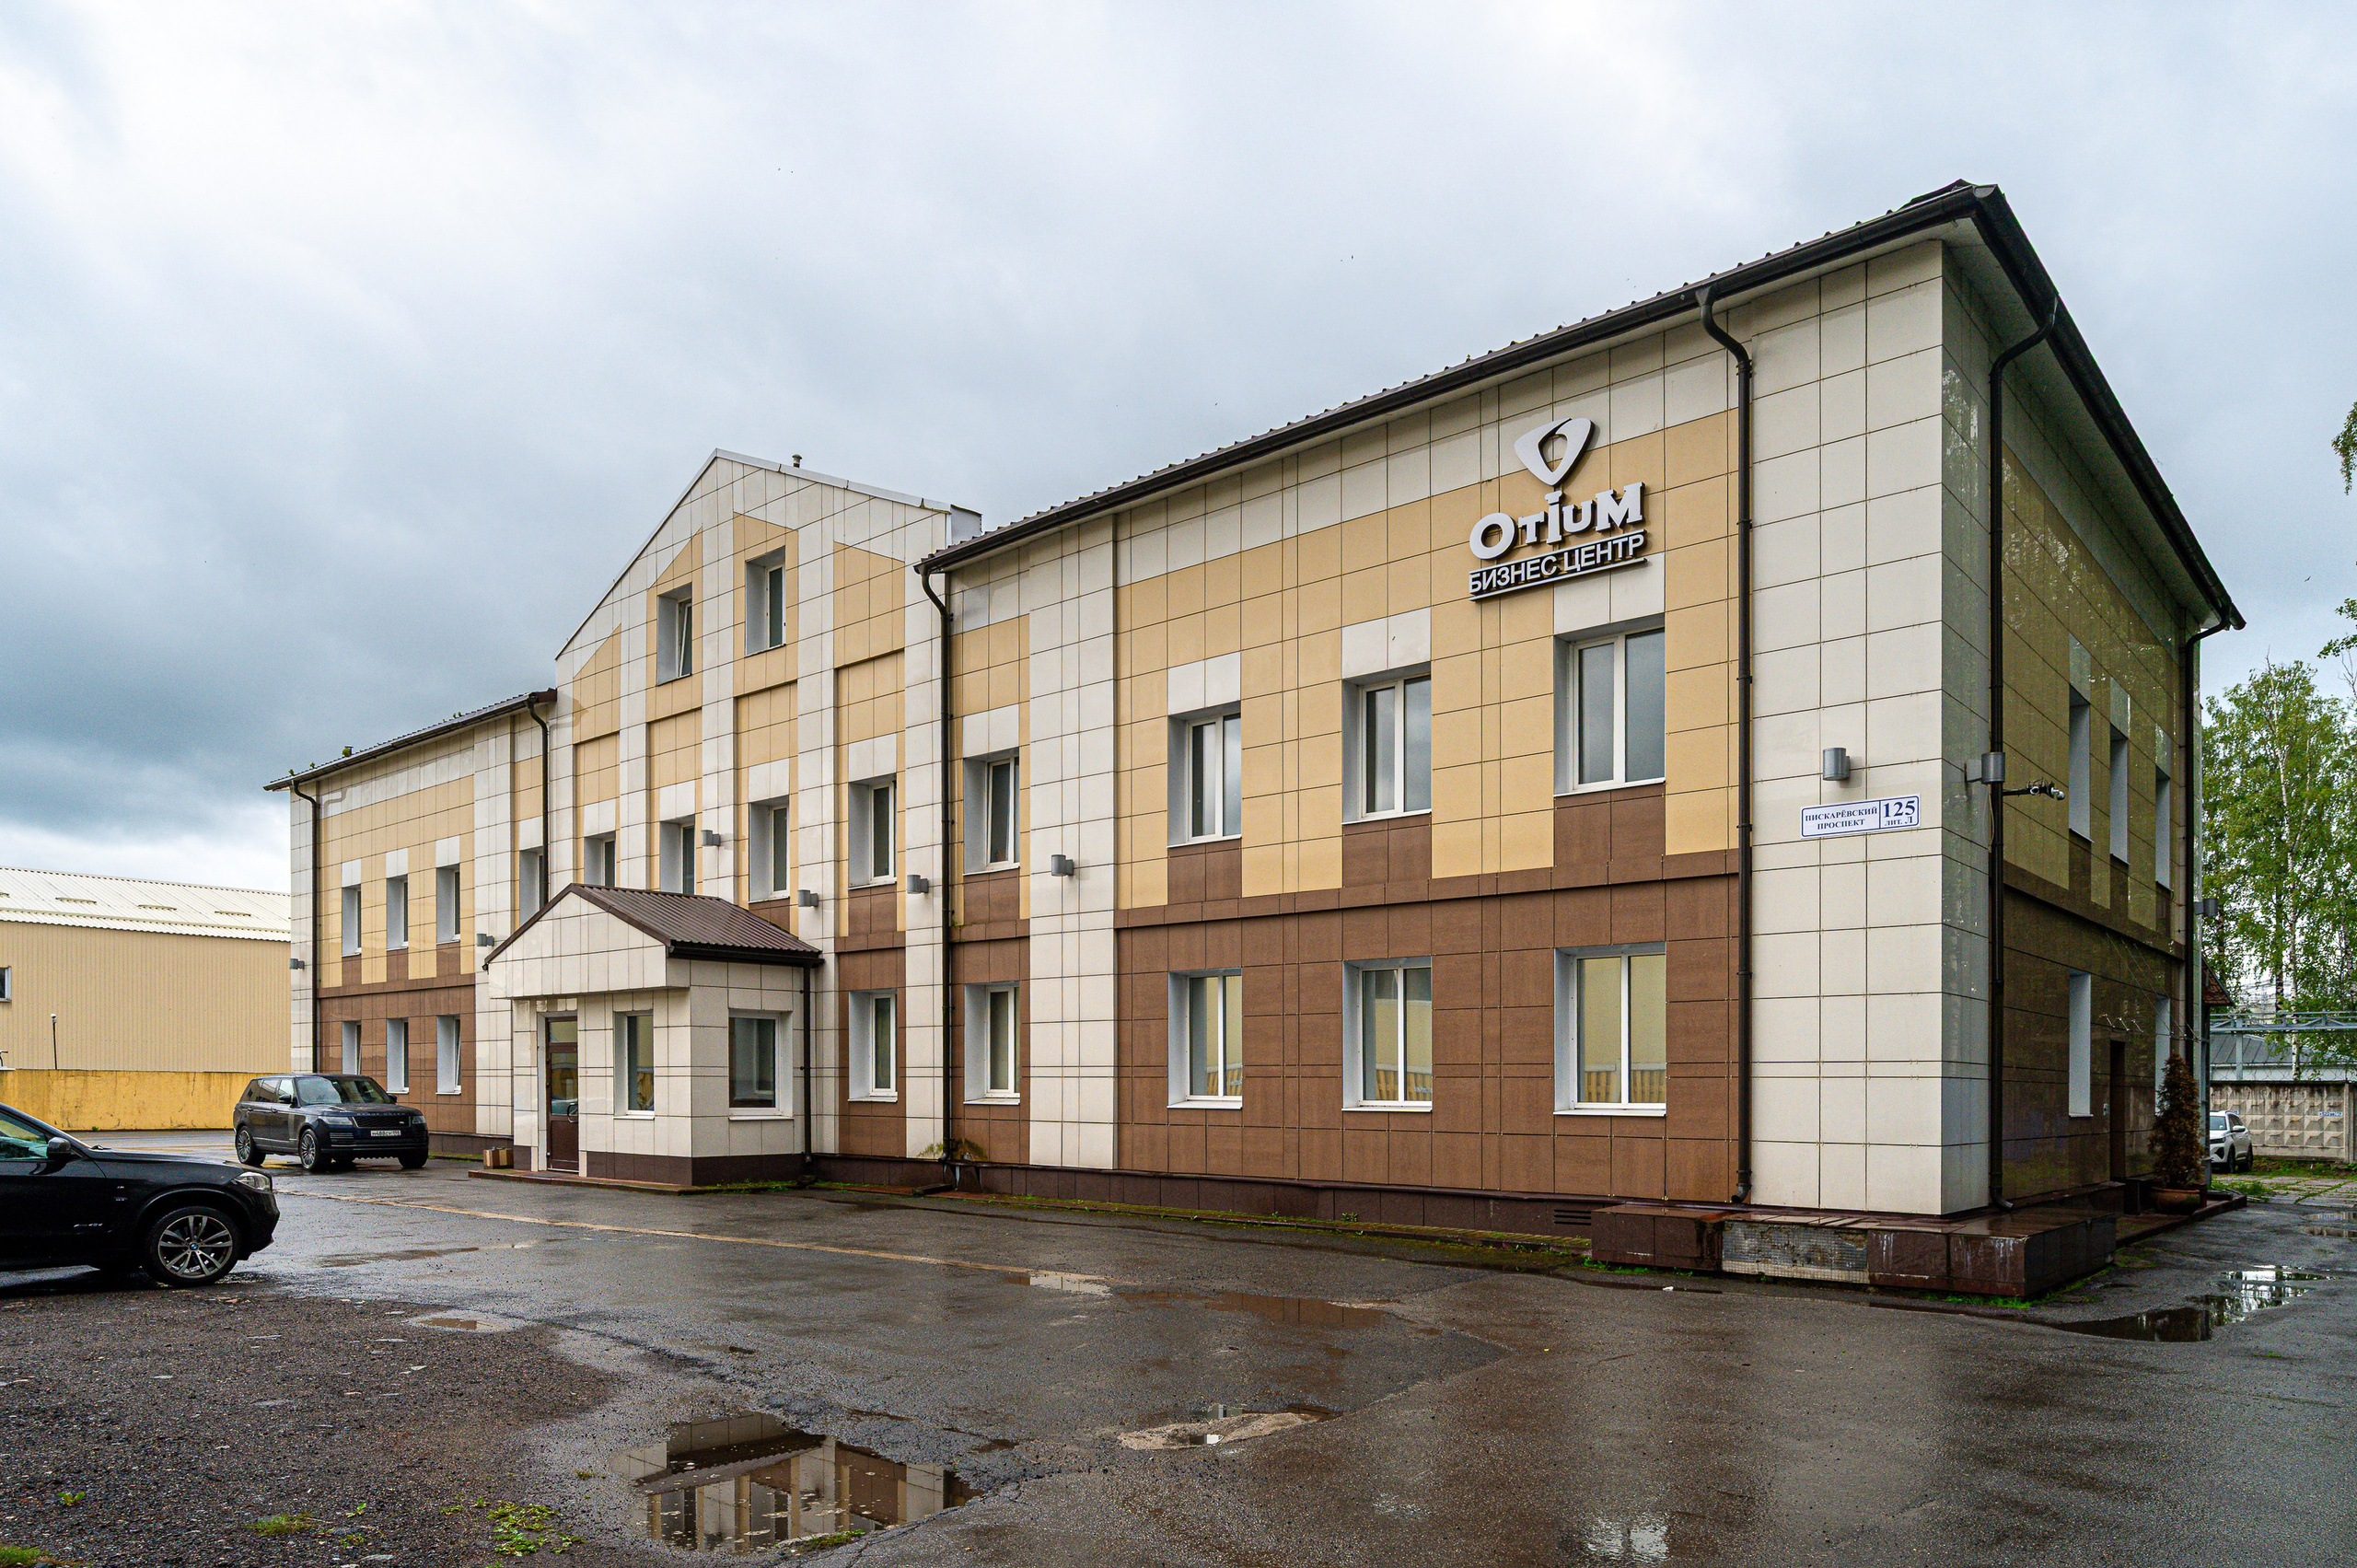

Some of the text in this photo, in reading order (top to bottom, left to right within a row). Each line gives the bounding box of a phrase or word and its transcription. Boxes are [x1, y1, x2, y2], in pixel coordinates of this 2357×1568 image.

[1469, 534, 1644, 594] БИЗНЕС ЦЕНТР
[1805, 807, 1877, 822] ПИСКАРЁВСКИЙ
[1883, 800, 1915, 818] 125
[1817, 819, 1865, 830] ПРОСПЕКТ
